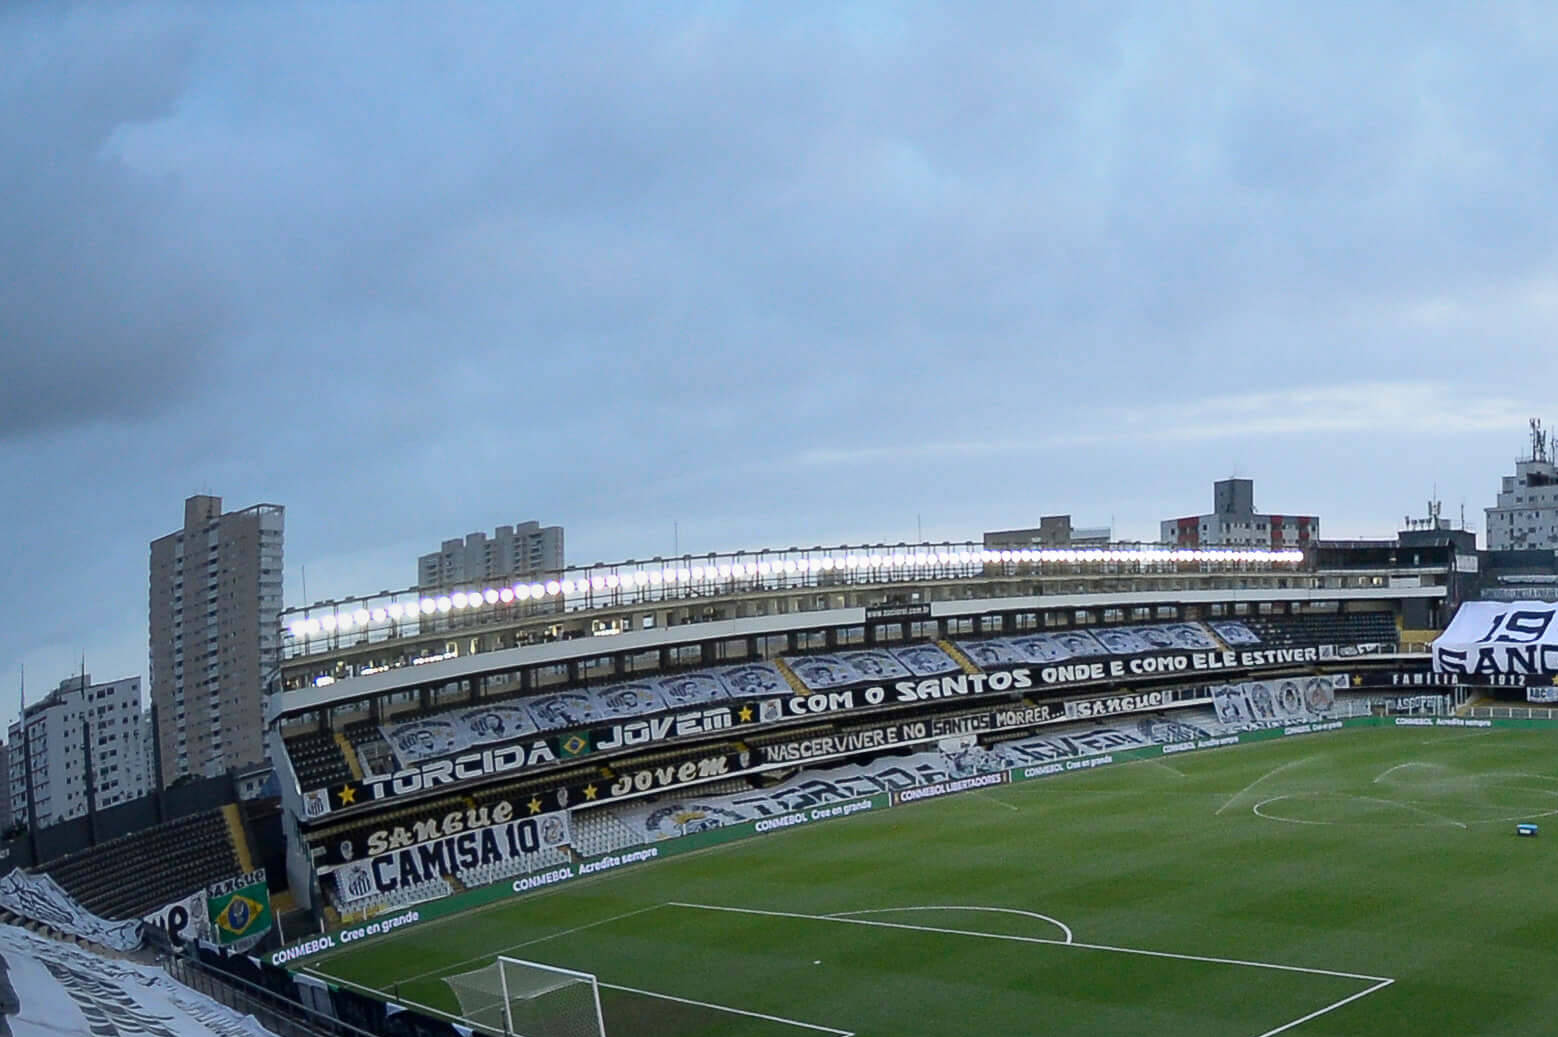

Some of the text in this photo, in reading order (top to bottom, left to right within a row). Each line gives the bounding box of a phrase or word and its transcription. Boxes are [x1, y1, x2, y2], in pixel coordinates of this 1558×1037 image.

[1476, 610, 1557, 644] 19
[788, 646, 1318, 715] COM O SANTOS ONDE E COMO ELE ESTIVER
[833, 730, 884, 750] VIVER
[887, 726, 898, 743] E
[902, 722, 926, 740] NO
[362, 739, 557, 799] TORCIDA
[900, 771, 1002, 803] CONMEBOL LIBERTADORES
[755, 811, 809, 833] CONMEBOL
[811, 808, 831, 822] Cree
[831, 807, 843, 818] en
[843, 799, 873, 818] grande
[371, 817, 541, 894] CAMISA 10
[512, 862, 574, 892] CONMEBOL
[622, 846, 659, 870] sempre
[271, 909, 420, 967] CONMEBOL Cree en grande
